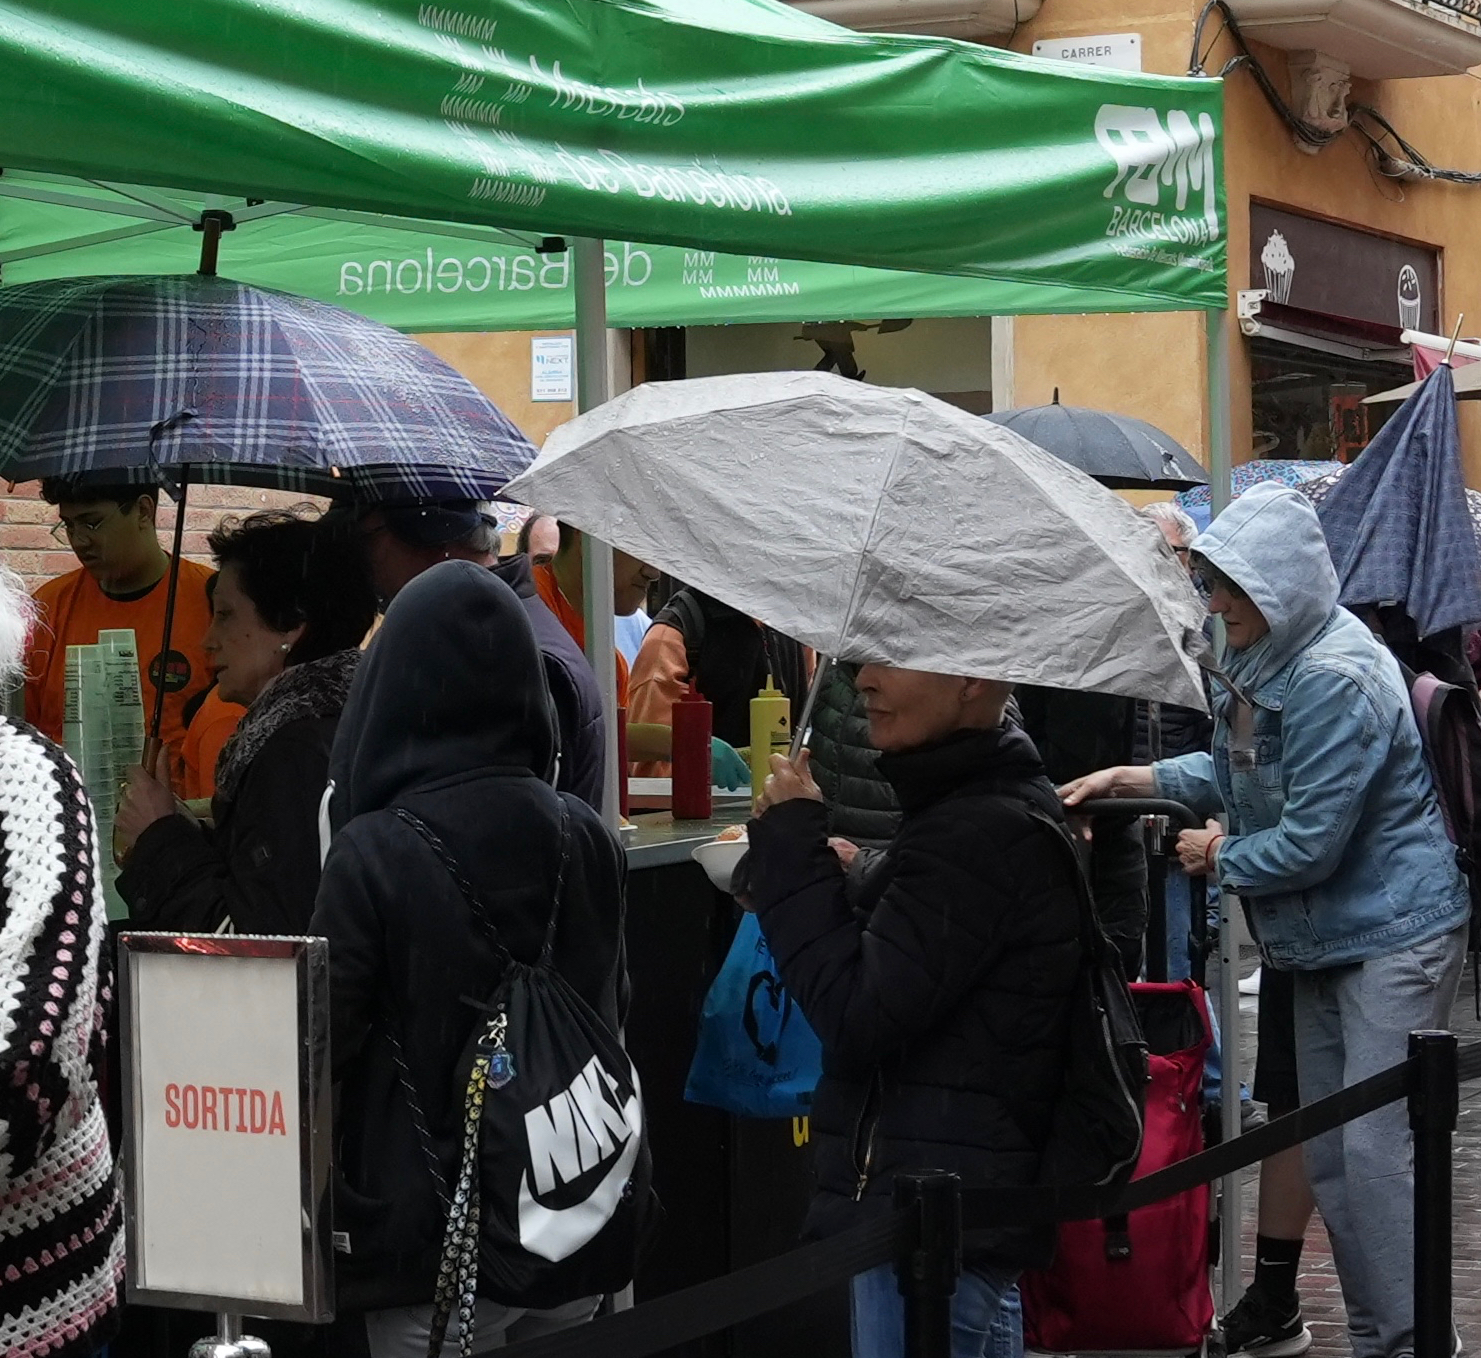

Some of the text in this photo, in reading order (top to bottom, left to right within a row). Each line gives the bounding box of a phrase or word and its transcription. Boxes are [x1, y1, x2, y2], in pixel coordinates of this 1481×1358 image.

[1061, 45, 1112, 59] CARRER
[1105, 205, 1209, 247] BARCELONA
[165, 1083, 286, 1136] SORTIDA
